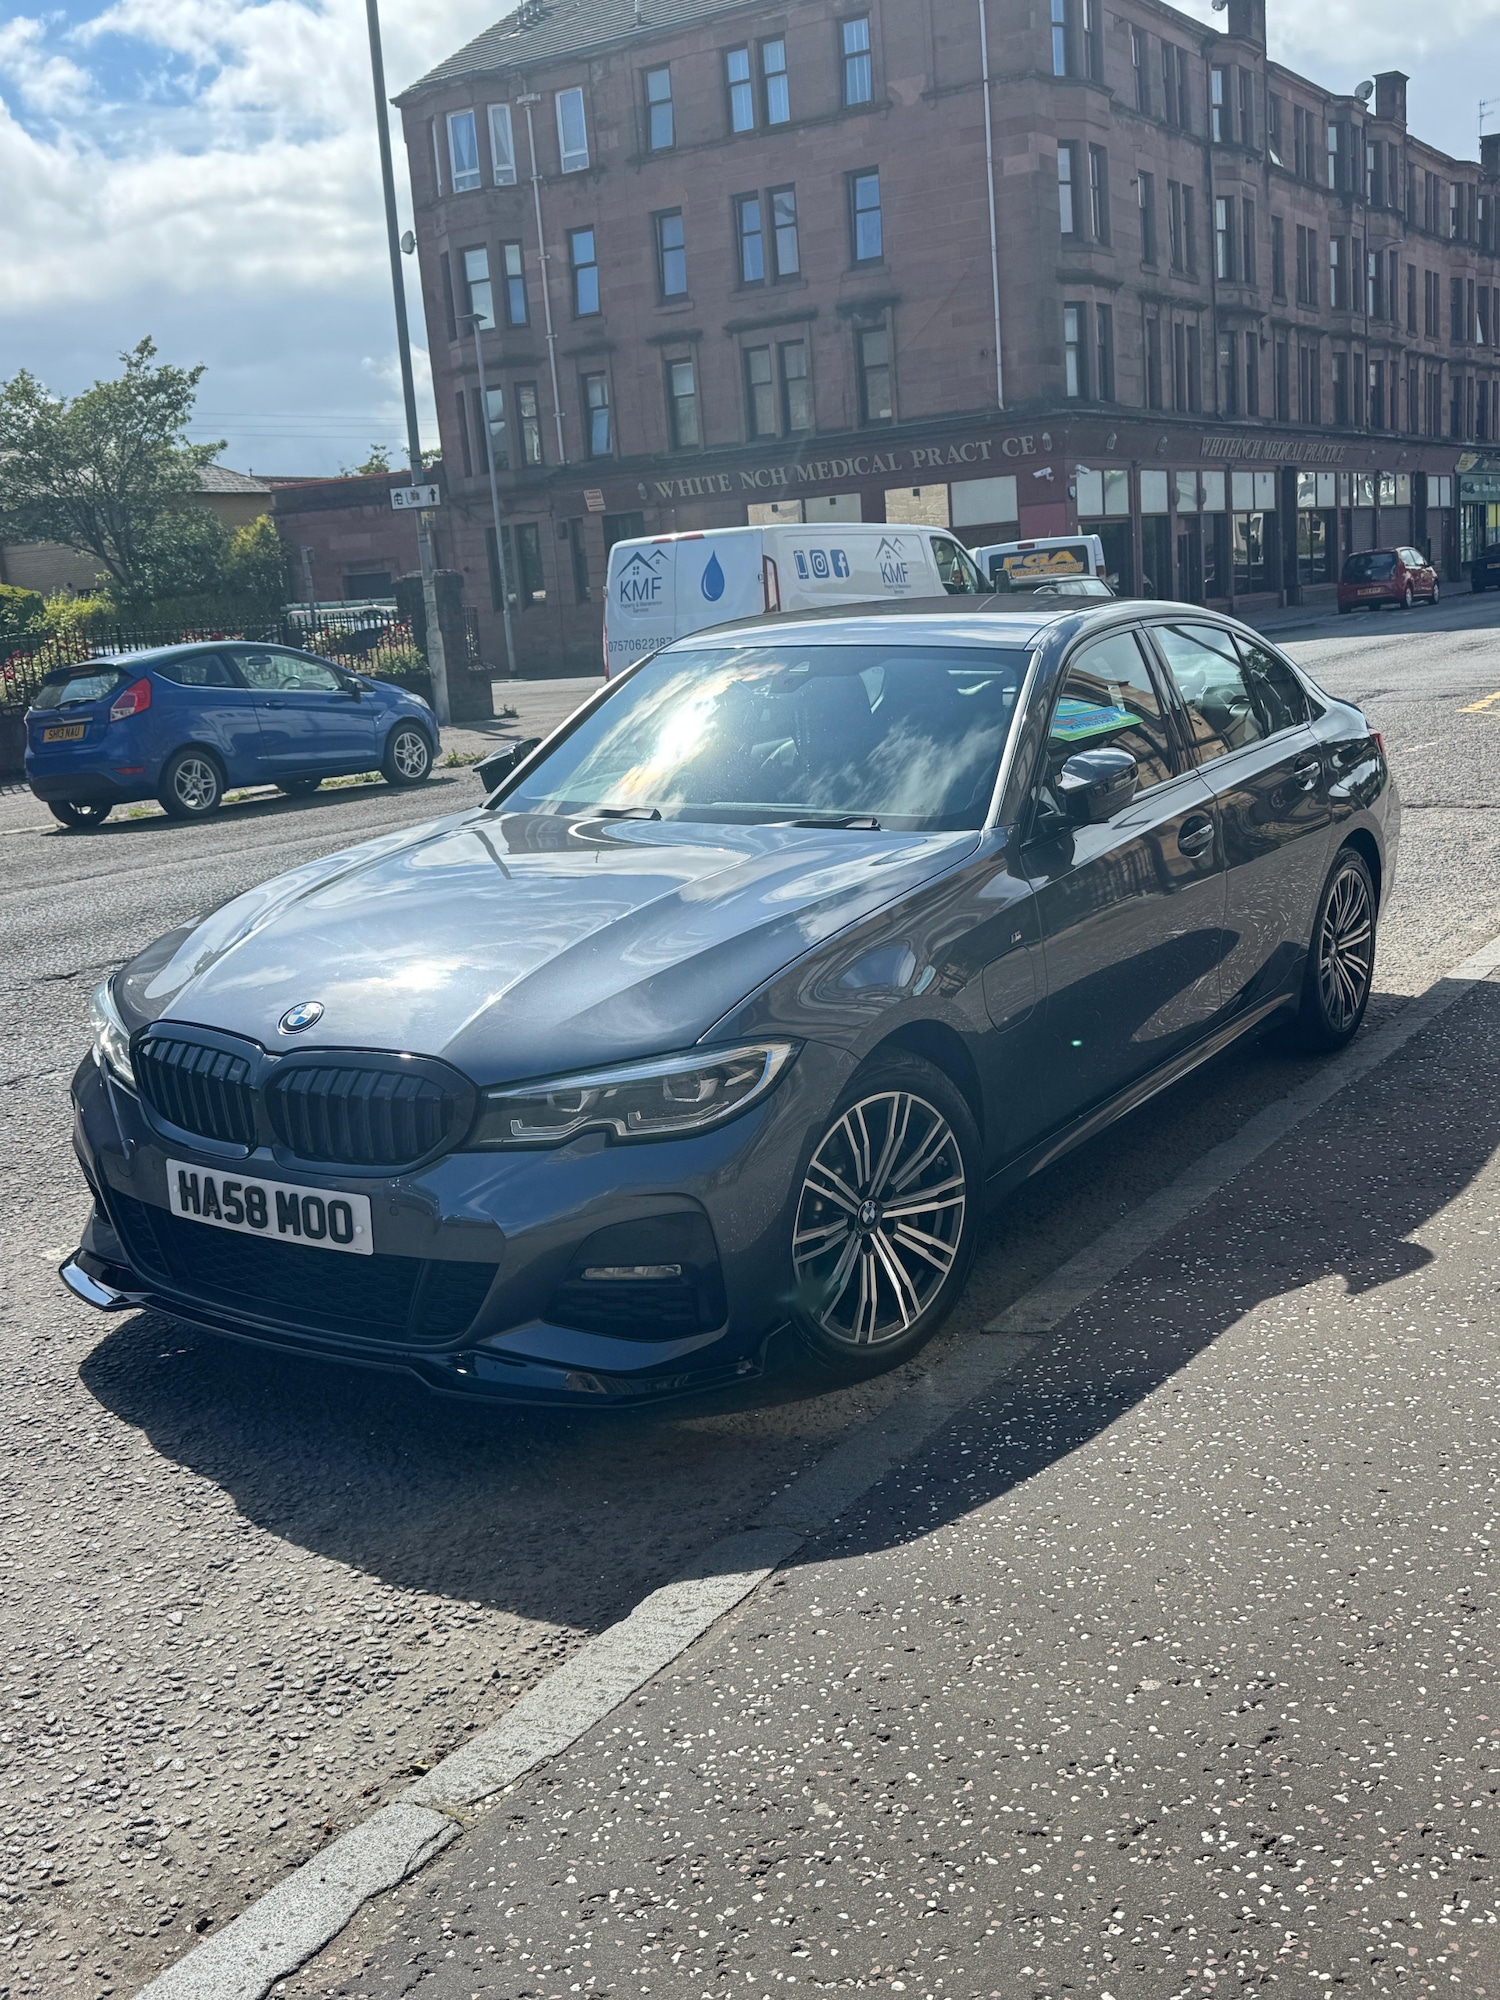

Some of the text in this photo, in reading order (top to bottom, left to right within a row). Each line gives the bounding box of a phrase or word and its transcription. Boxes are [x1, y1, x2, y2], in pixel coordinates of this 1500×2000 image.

[1200, 437, 1346, 463] WHITEINCH MEDICAL PRACTICE
[655, 474, 732, 498] WHITE
[796, 453, 902, 483] MEDICAL
[880, 562, 908, 583] KMF
[620, 577, 662, 602] KMF
[178, 1170, 354, 1244] HA58 MOO
